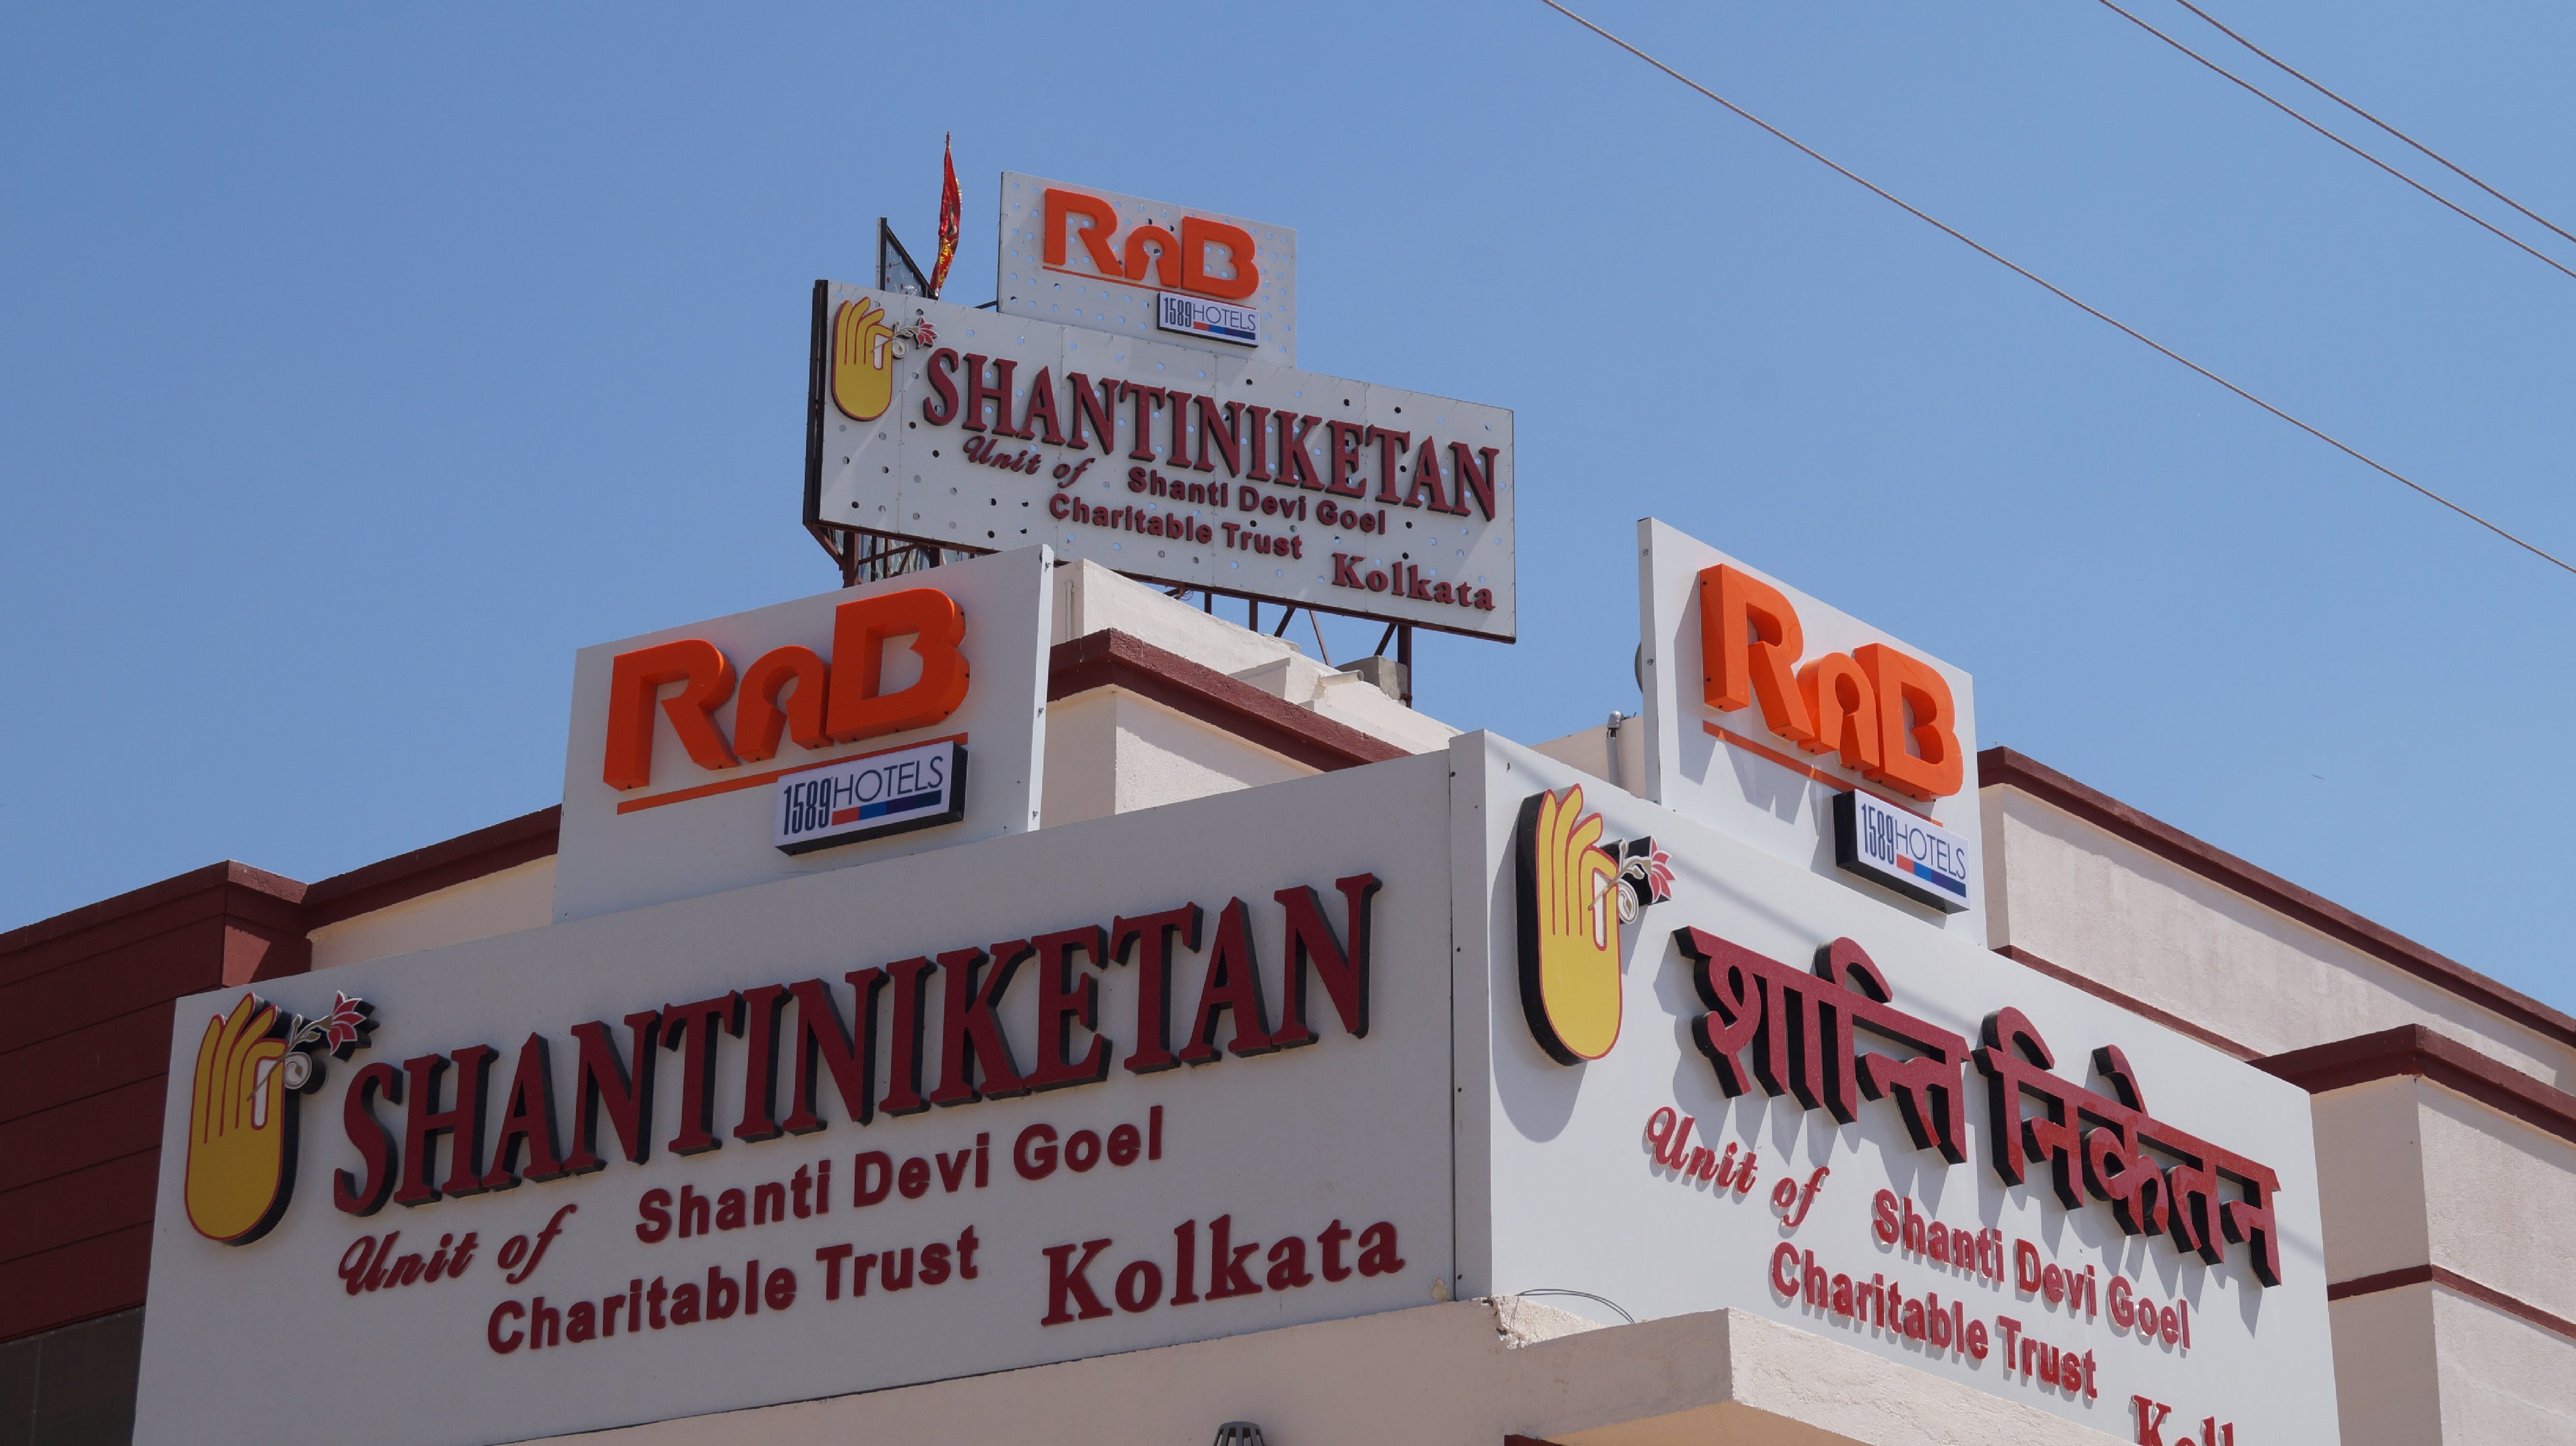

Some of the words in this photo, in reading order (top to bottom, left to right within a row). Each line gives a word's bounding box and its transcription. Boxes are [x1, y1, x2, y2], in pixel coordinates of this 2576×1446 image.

[923, 346, 1499, 523] SHANTINIKETAN
[963, 434, 1041, 476] Unit
[1052, 457, 1095, 489] of
[1127, 466, 1229, 508] Shanti
[1239, 485, 1307, 523] Devi
[1316, 498, 1386, 536] Goel
[1049, 492, 1213, 545] Charitable
[1222, 521, 1304, 560] Trust
[1331, 552, 1496, 611] Kolkata
[333, 873, 1383, 1217] SHANTINIKETAN
[338, 1230, 479, 1296] Unit
[497, 1203, 577, 1285] of
[635, 1159, 830, 1245] Shanti
[853, 1132, 990, 1209] Devi
[1012, 1105, 1164, 1182] Goel
[1040, 1213, 1405, 1327] Kolkata
[1644, 1105, 1759, 1196] Unit
[1772, 1165, 1831, 1229] of
[1872, 1188, 2005, 1285] Shanti
[2015, 1238, 2098, 1319] Devi
[2107, 1274, 2192, 1352] Goel
[487, 1259, 797, 1355] Charitable
[815, 1224, 979, 1303] Trust
[1770, 1240, 1990, 1362] Charitable
[1996, 1314, 2100, 1401] Trust
